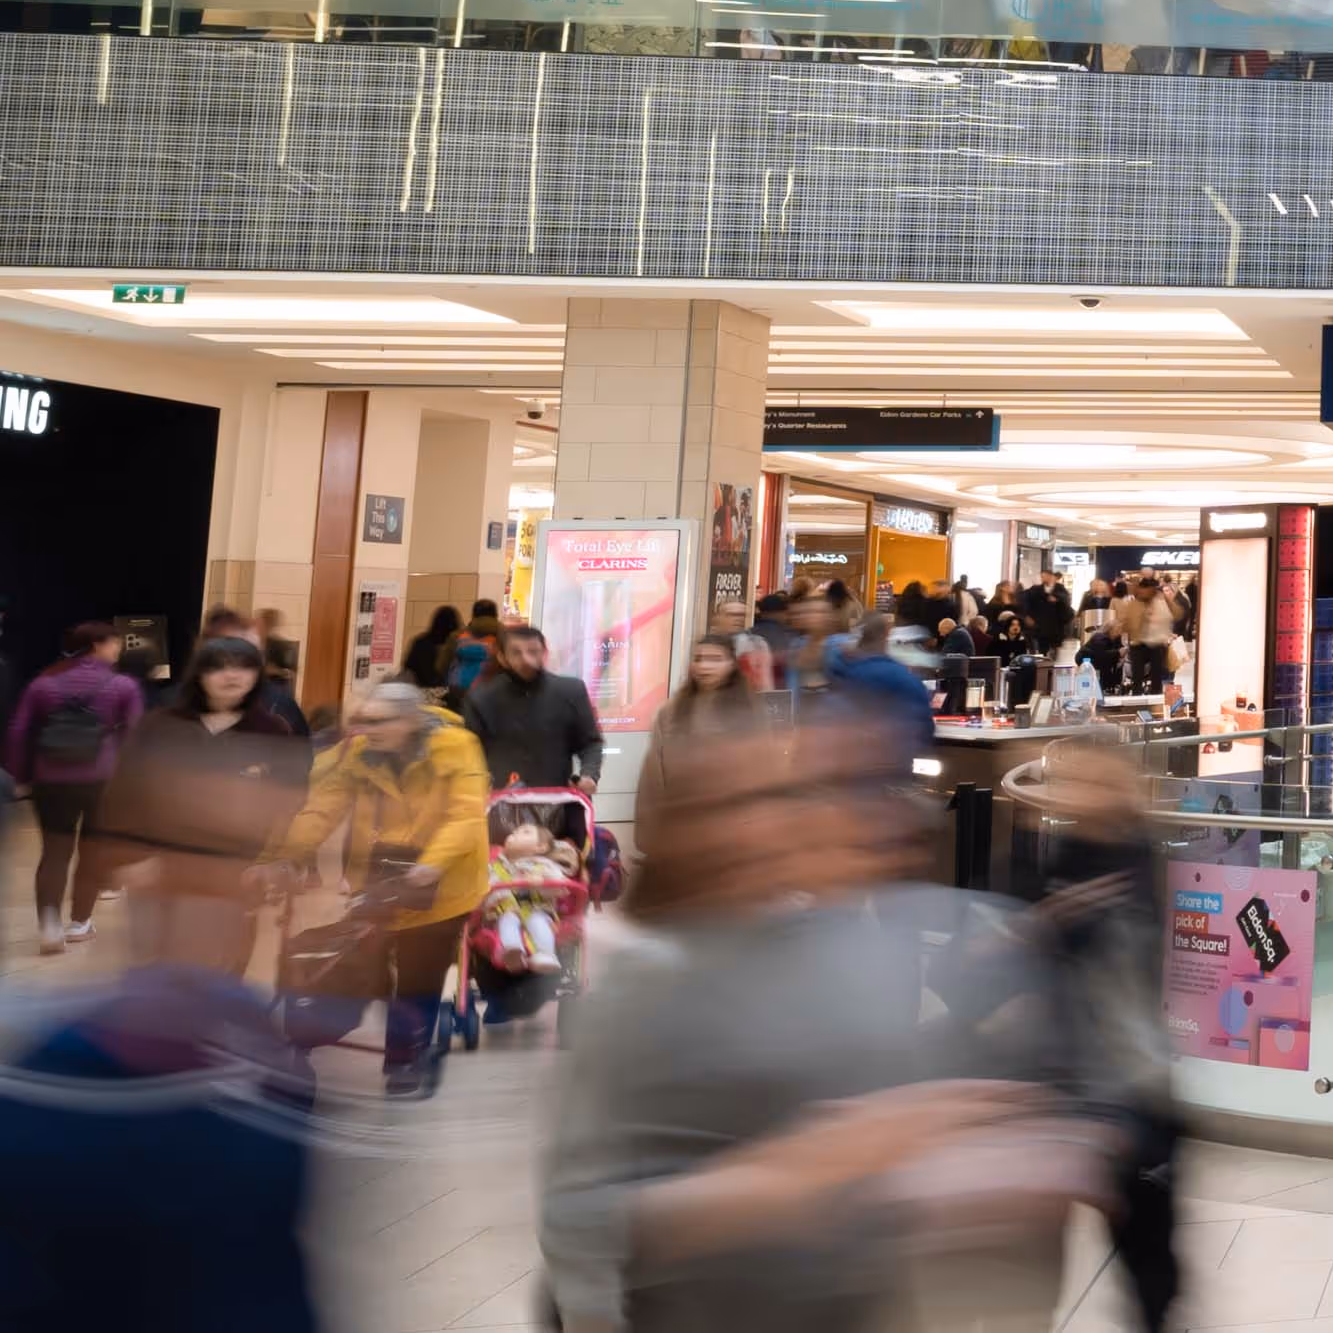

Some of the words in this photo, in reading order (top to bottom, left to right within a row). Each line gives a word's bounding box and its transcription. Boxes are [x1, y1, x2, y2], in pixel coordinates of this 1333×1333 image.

[0, 385, 51, 435] NG
[375, 497, 387, 510] Lift
[371, 511, 386, 524] This
[369, 525, 385, 540] Way
[564, 538, 601, 554] Total
[605, 539, 633, 555] Eye
[578, 558, 649, 570] CLARINS
[1140, 551, 1200, 566] SKE
[1176, 894, 1203, 908] Share
[1203, 897, 1220, 910] the
[1175, 914, 1194, 930] pick
[1195, 916, 1206, 929] of
[1246, 905, 1276, 963] EldonSq.
[1175, 934, 1190, 948] the
[1191, 936, 1227, 953] Square!
